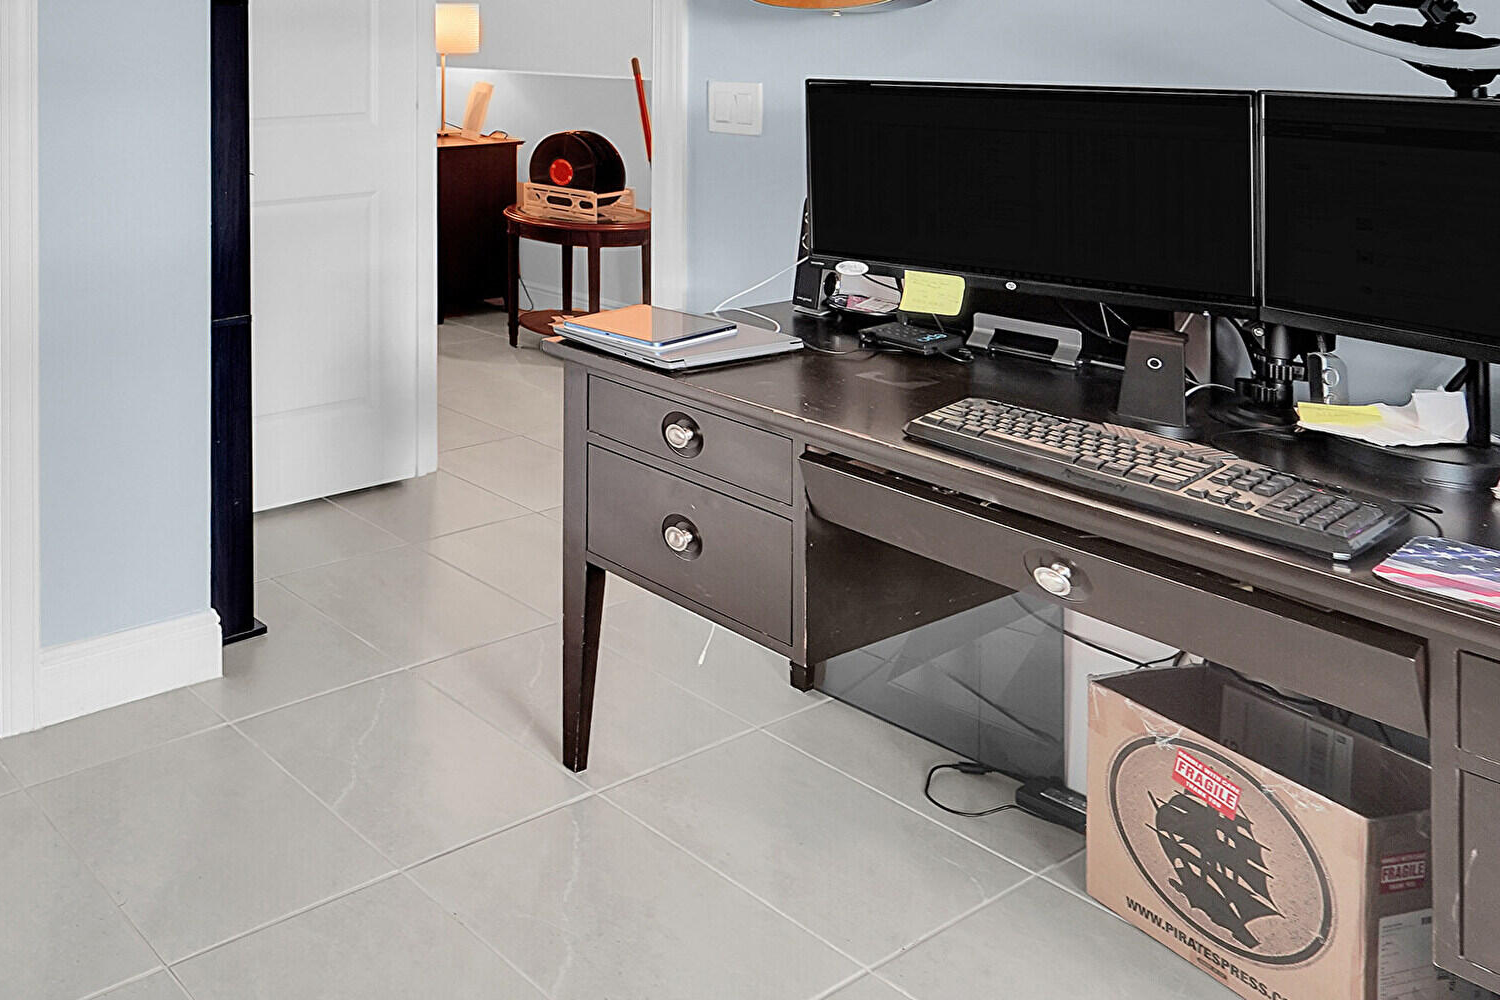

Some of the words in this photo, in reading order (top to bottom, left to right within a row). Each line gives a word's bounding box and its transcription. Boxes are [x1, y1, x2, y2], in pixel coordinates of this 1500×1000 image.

[1177, 760, 1236, 808] FRAGILE
[1185, 781, 1207, 799] THANK
[1204, 767, 1222, 782] WITH
[1222, 779, 1240, 794] CARE
[1126, 896, 1288, 1000] WWW.PIRATESPRESS.C
